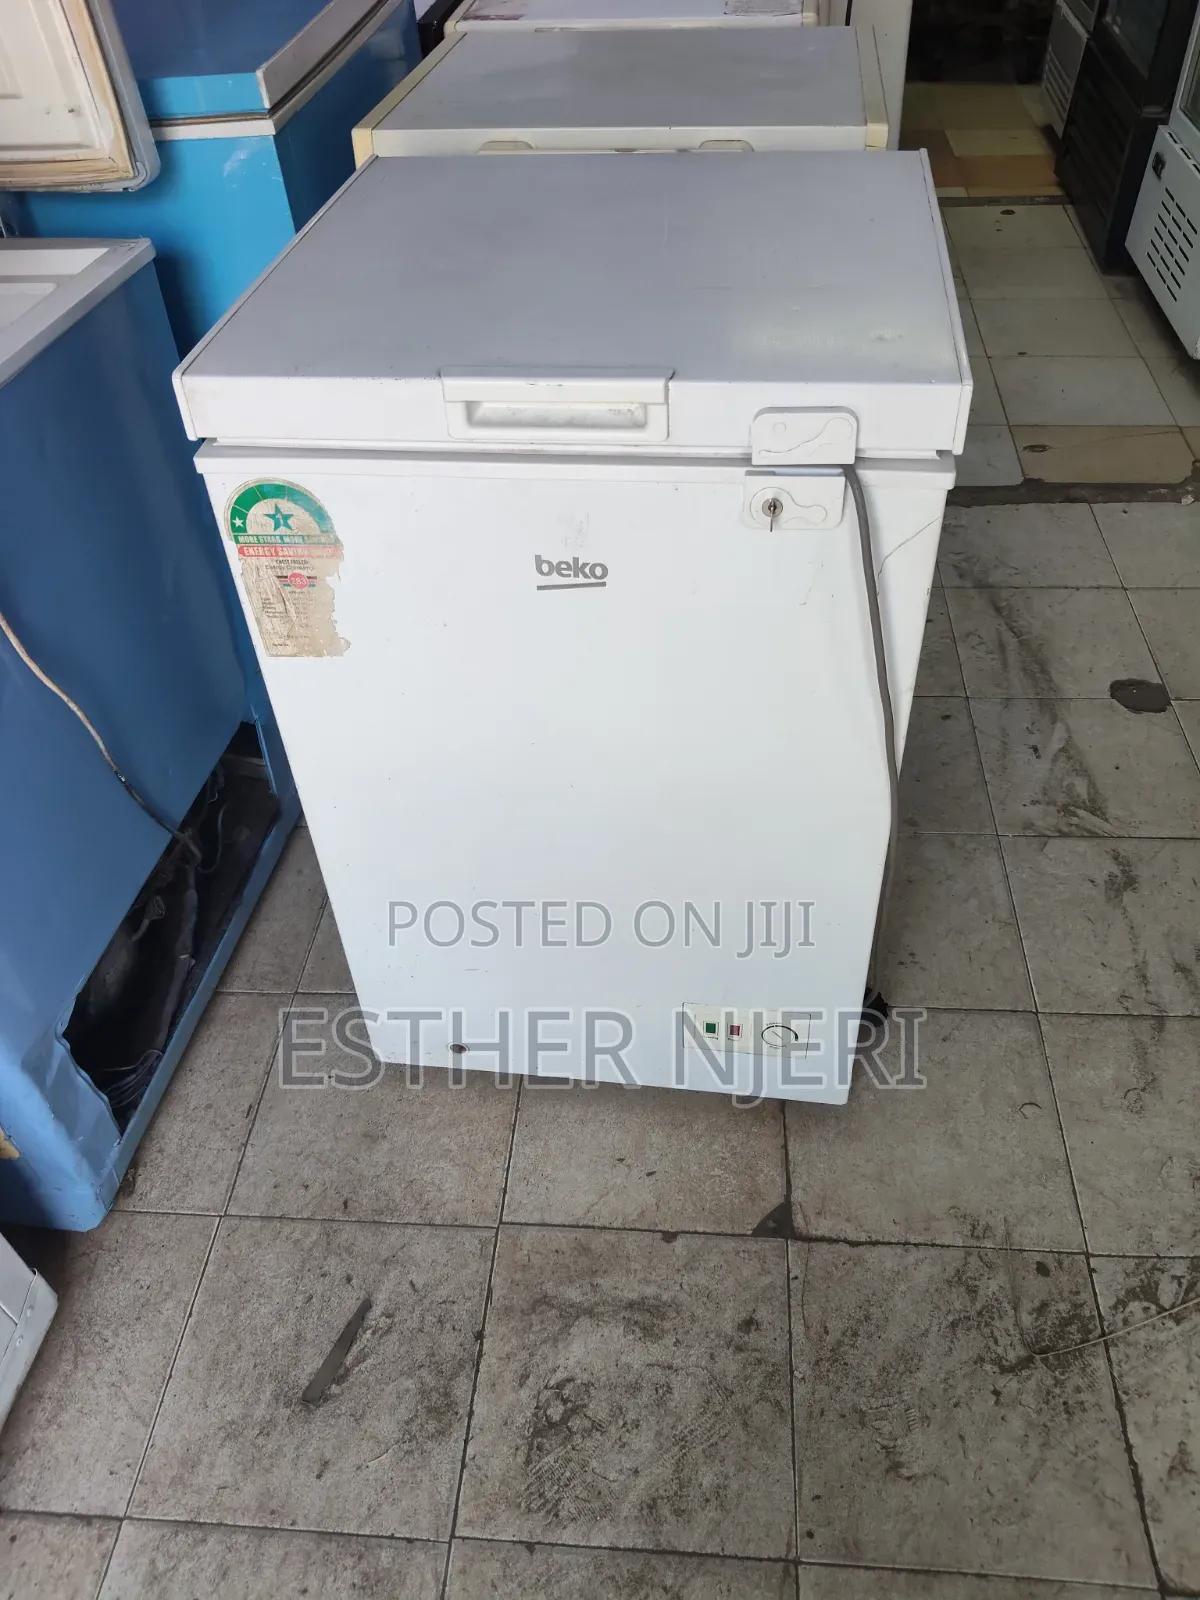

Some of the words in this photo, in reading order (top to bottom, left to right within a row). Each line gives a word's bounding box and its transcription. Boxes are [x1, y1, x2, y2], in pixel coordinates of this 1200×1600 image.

[238, 535, 259, 544] MORE
[244, 546, 276, 557] ENERGY
[535, 554, 609, 580] beko
[290, 577, 307, 585] 283
